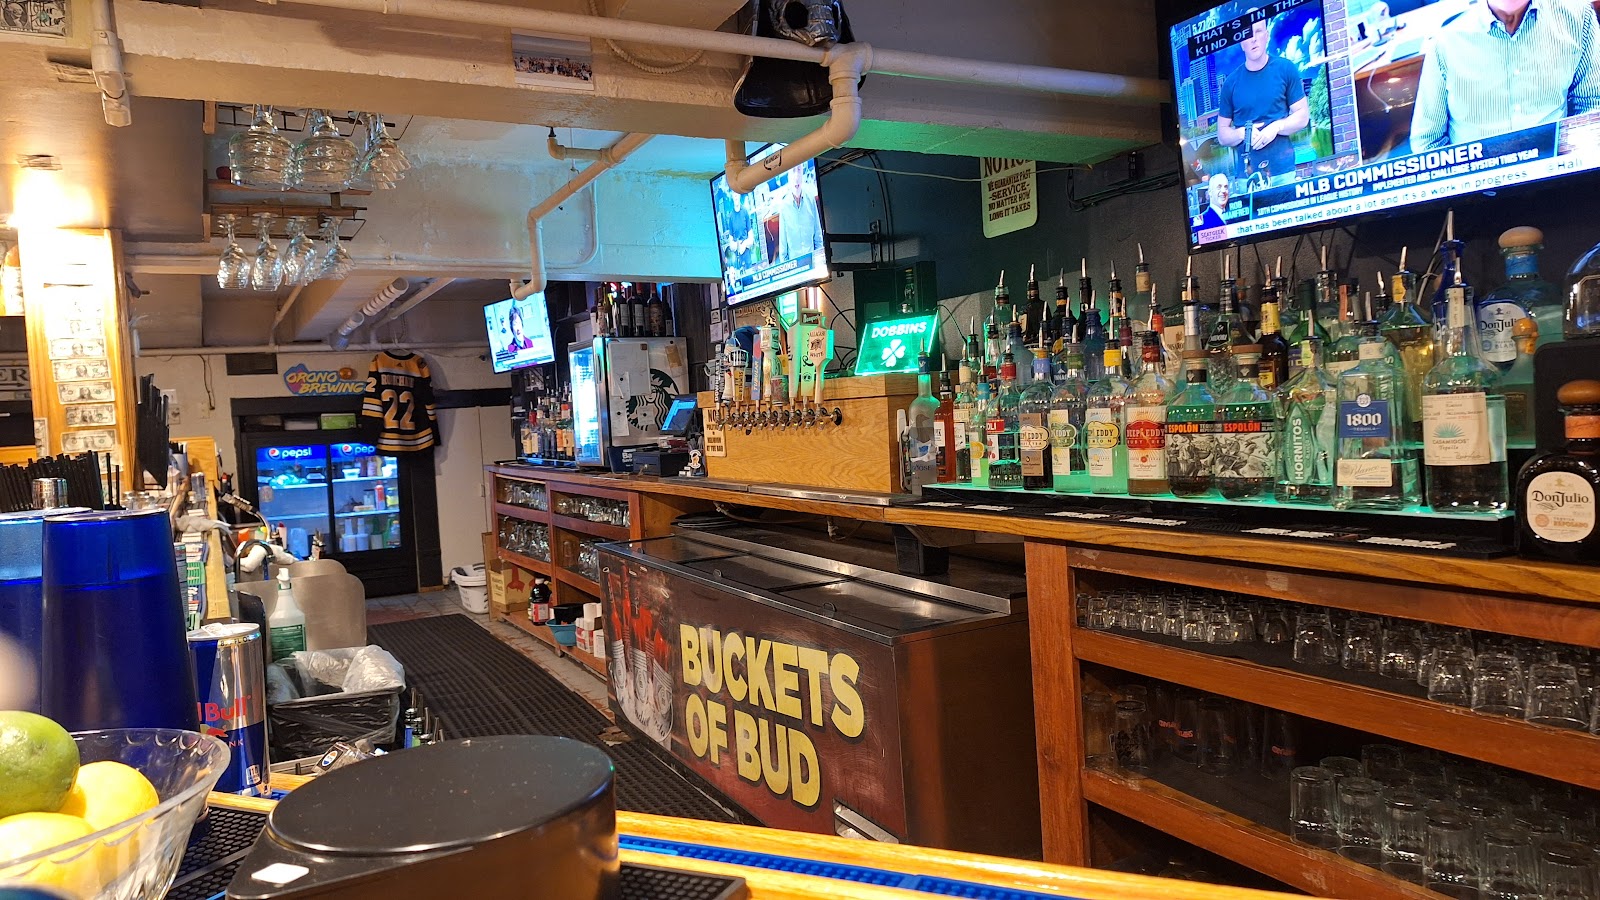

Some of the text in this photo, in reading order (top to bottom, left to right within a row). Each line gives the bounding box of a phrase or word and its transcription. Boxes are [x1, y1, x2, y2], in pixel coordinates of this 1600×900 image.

[1194, 0, 1300, 44] THAT'S IN THE
[1195, 28, 1251, 56] KIND OF
[984, 157, 1032, 178] NOTI
[1295, 142, 1483, 198] MLB COMMISSIONER
[989, 210, 1004, 222] LONG
[1012, 201, 1031, 215] TAKES
[1237, 224, 1253, 234] that
[1255, 221, 1270, 231] has
[1272, 216, 1293, 228] been
[1294, 210, 1323, 224] talked
[1326, 203, 1353, 217] about
[1364, 199, 1377, 209] lot
[1380, 193, 1399, 206] and
[1431, 183, 1457, 195] work
[1461, 180, 1471, 190] in
[1475, 170, 1528, 188] progress
[871, 321, 927, 338] DOBBINS
[286, 372, 338, 384] ORONO
[299, 383, 365, 394] BREWING
[381, 389, 416, 430] 22
[1346, 413, 1382, 426] 1800
[1096, 428, 1114, 437] EDDY
[1145, 428, 1165, 438] EDDY
[281, 447, 313, 459] pepsi
[354, 445, 375, 456] pep
[1292, 418, 1304, 480] HORNITOS
[680, 623, 865, 738] BUCKETS
[205, 695, 247, 722] Bull
[685, 693, 821, 807] OF BUD
